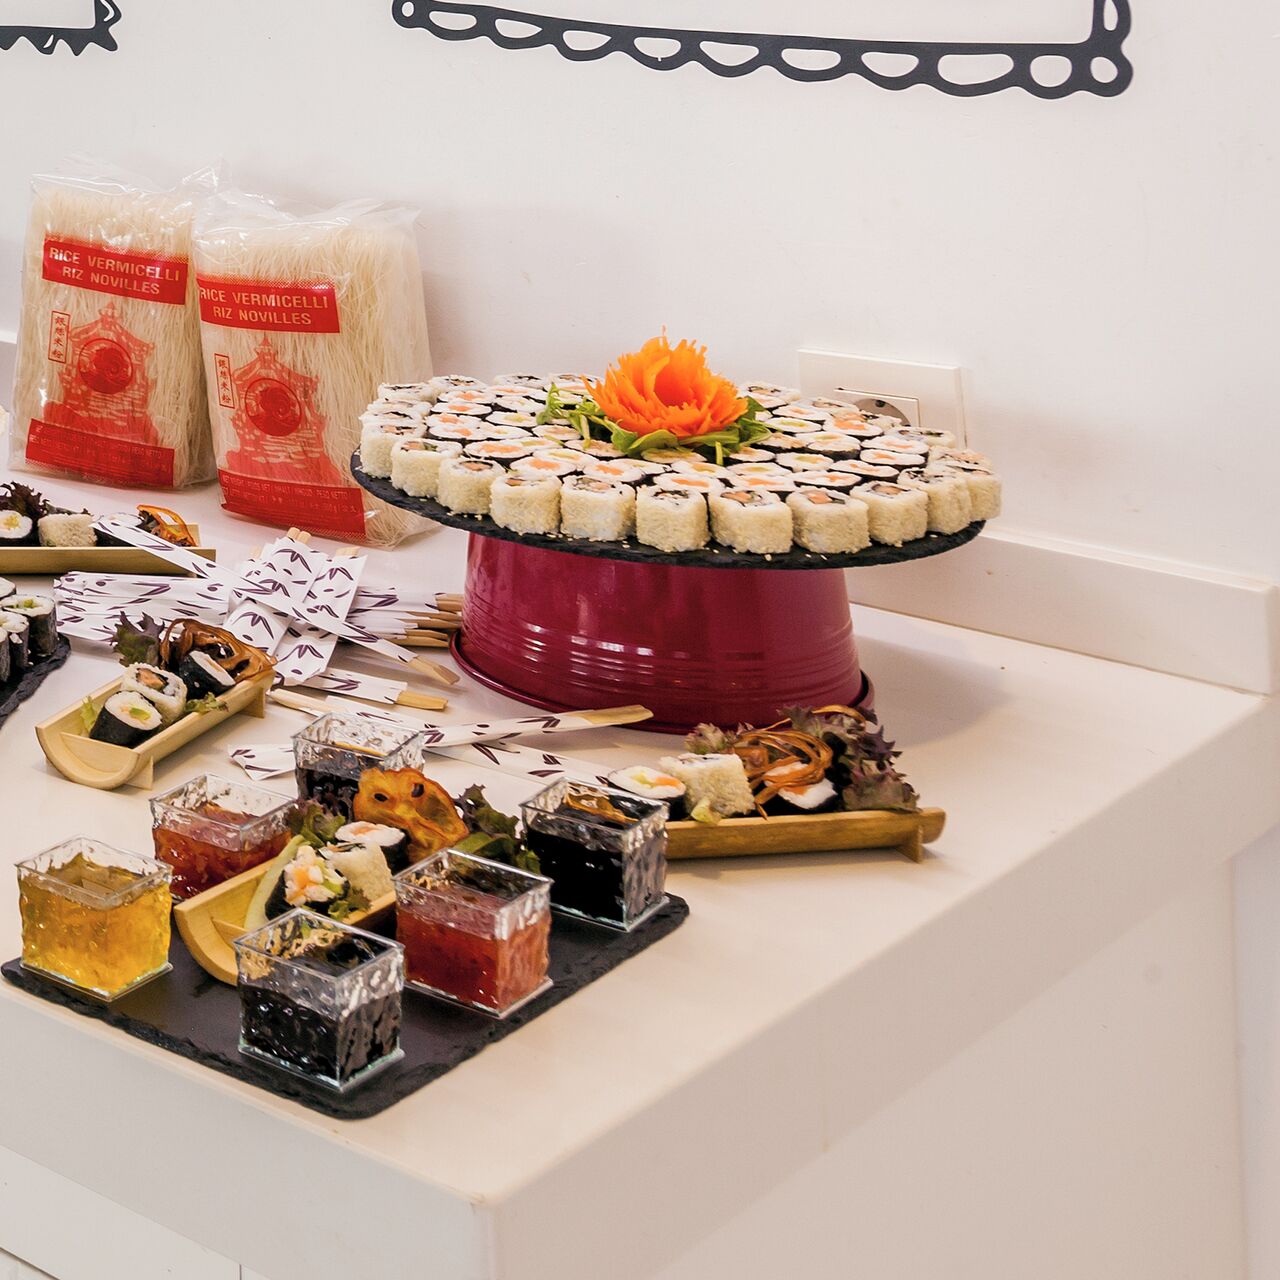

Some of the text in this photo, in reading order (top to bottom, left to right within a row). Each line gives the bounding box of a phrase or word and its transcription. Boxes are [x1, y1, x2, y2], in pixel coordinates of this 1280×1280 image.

[49, 247, 180, 281] RICE VERMICELLI
[62, 266, 160, 295] RIZ NOVILLES
[200, 287, 328, 309] RICE VERMICELLI
[213, 306, 312, 325] RIZ NOVILLES
